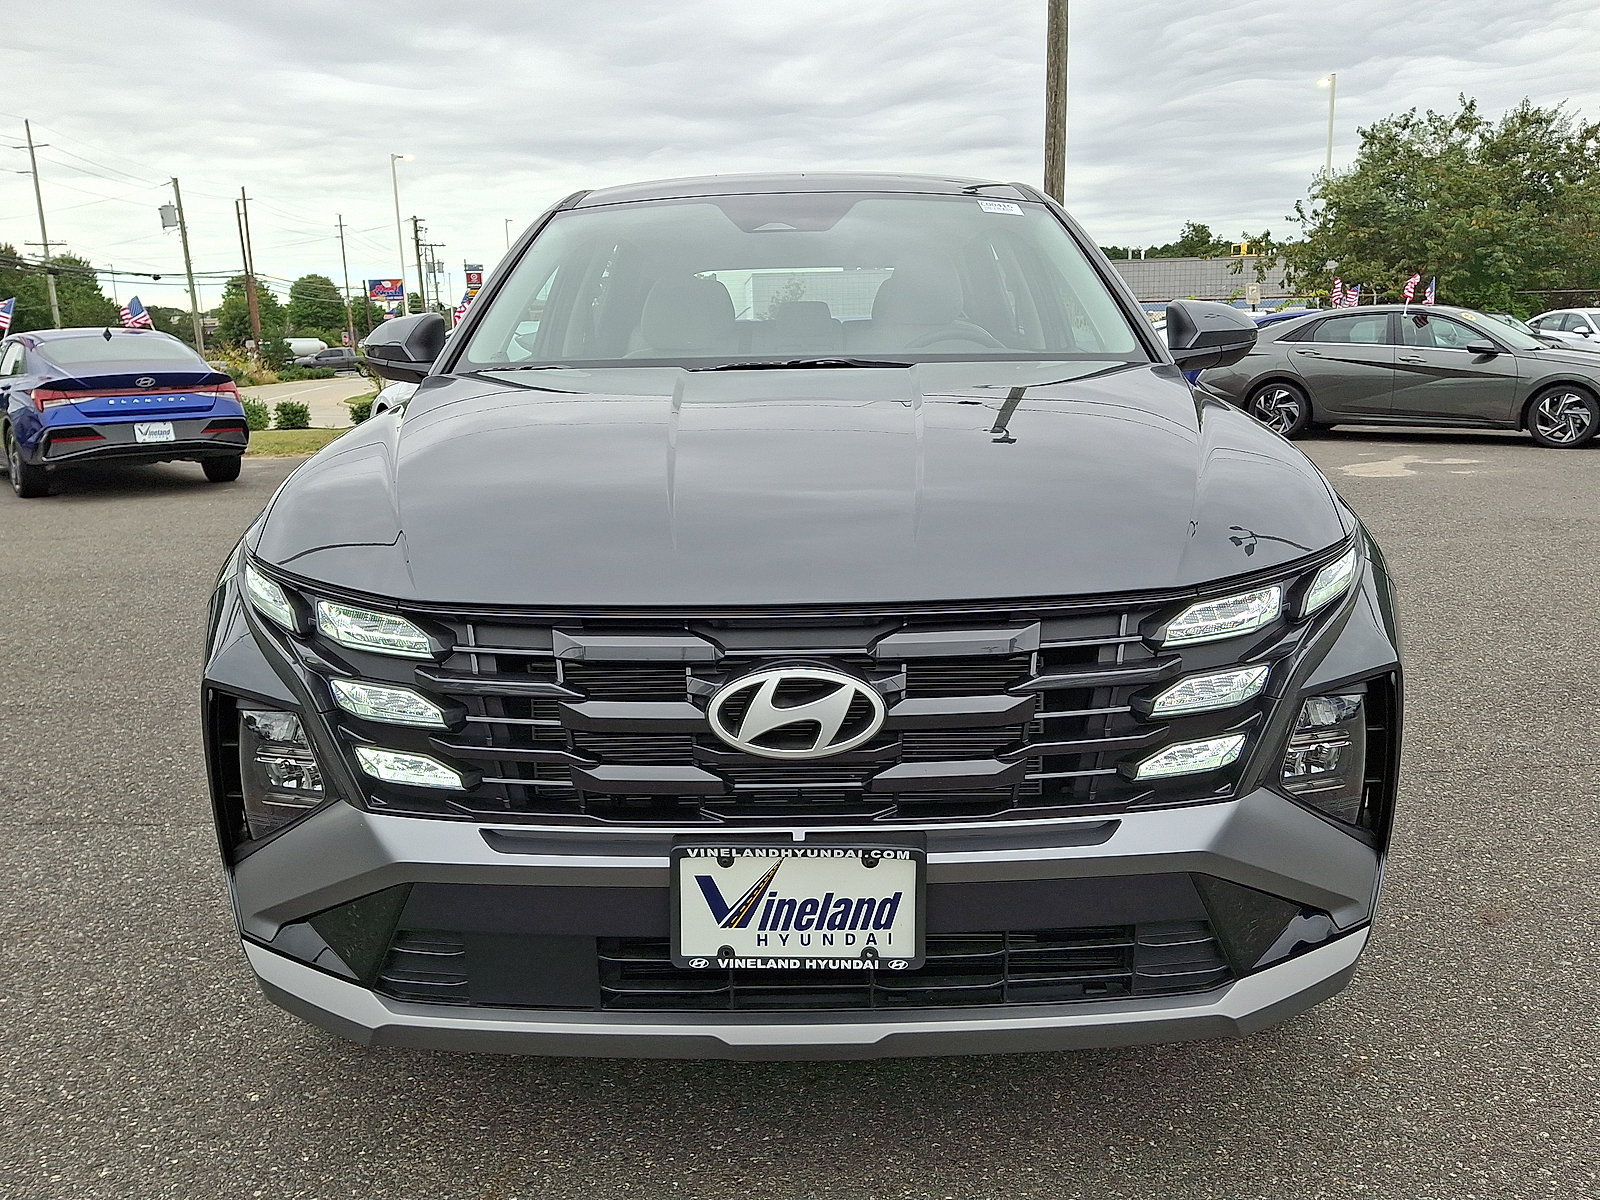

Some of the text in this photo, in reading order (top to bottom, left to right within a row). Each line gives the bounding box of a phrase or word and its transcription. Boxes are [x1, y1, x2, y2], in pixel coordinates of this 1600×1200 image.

[108, 396, 186, 405] ELANTRA
[137, 423, 171, 437] Vineland
[686, 847, 911, 861] VINELANDHYUNDAI.COM
[693, 857, 904, 932] Vineland
[756, 932, 893, 948] HYUNDAI
[717, 957, 880, 970] VINELAND HYUNDAI
